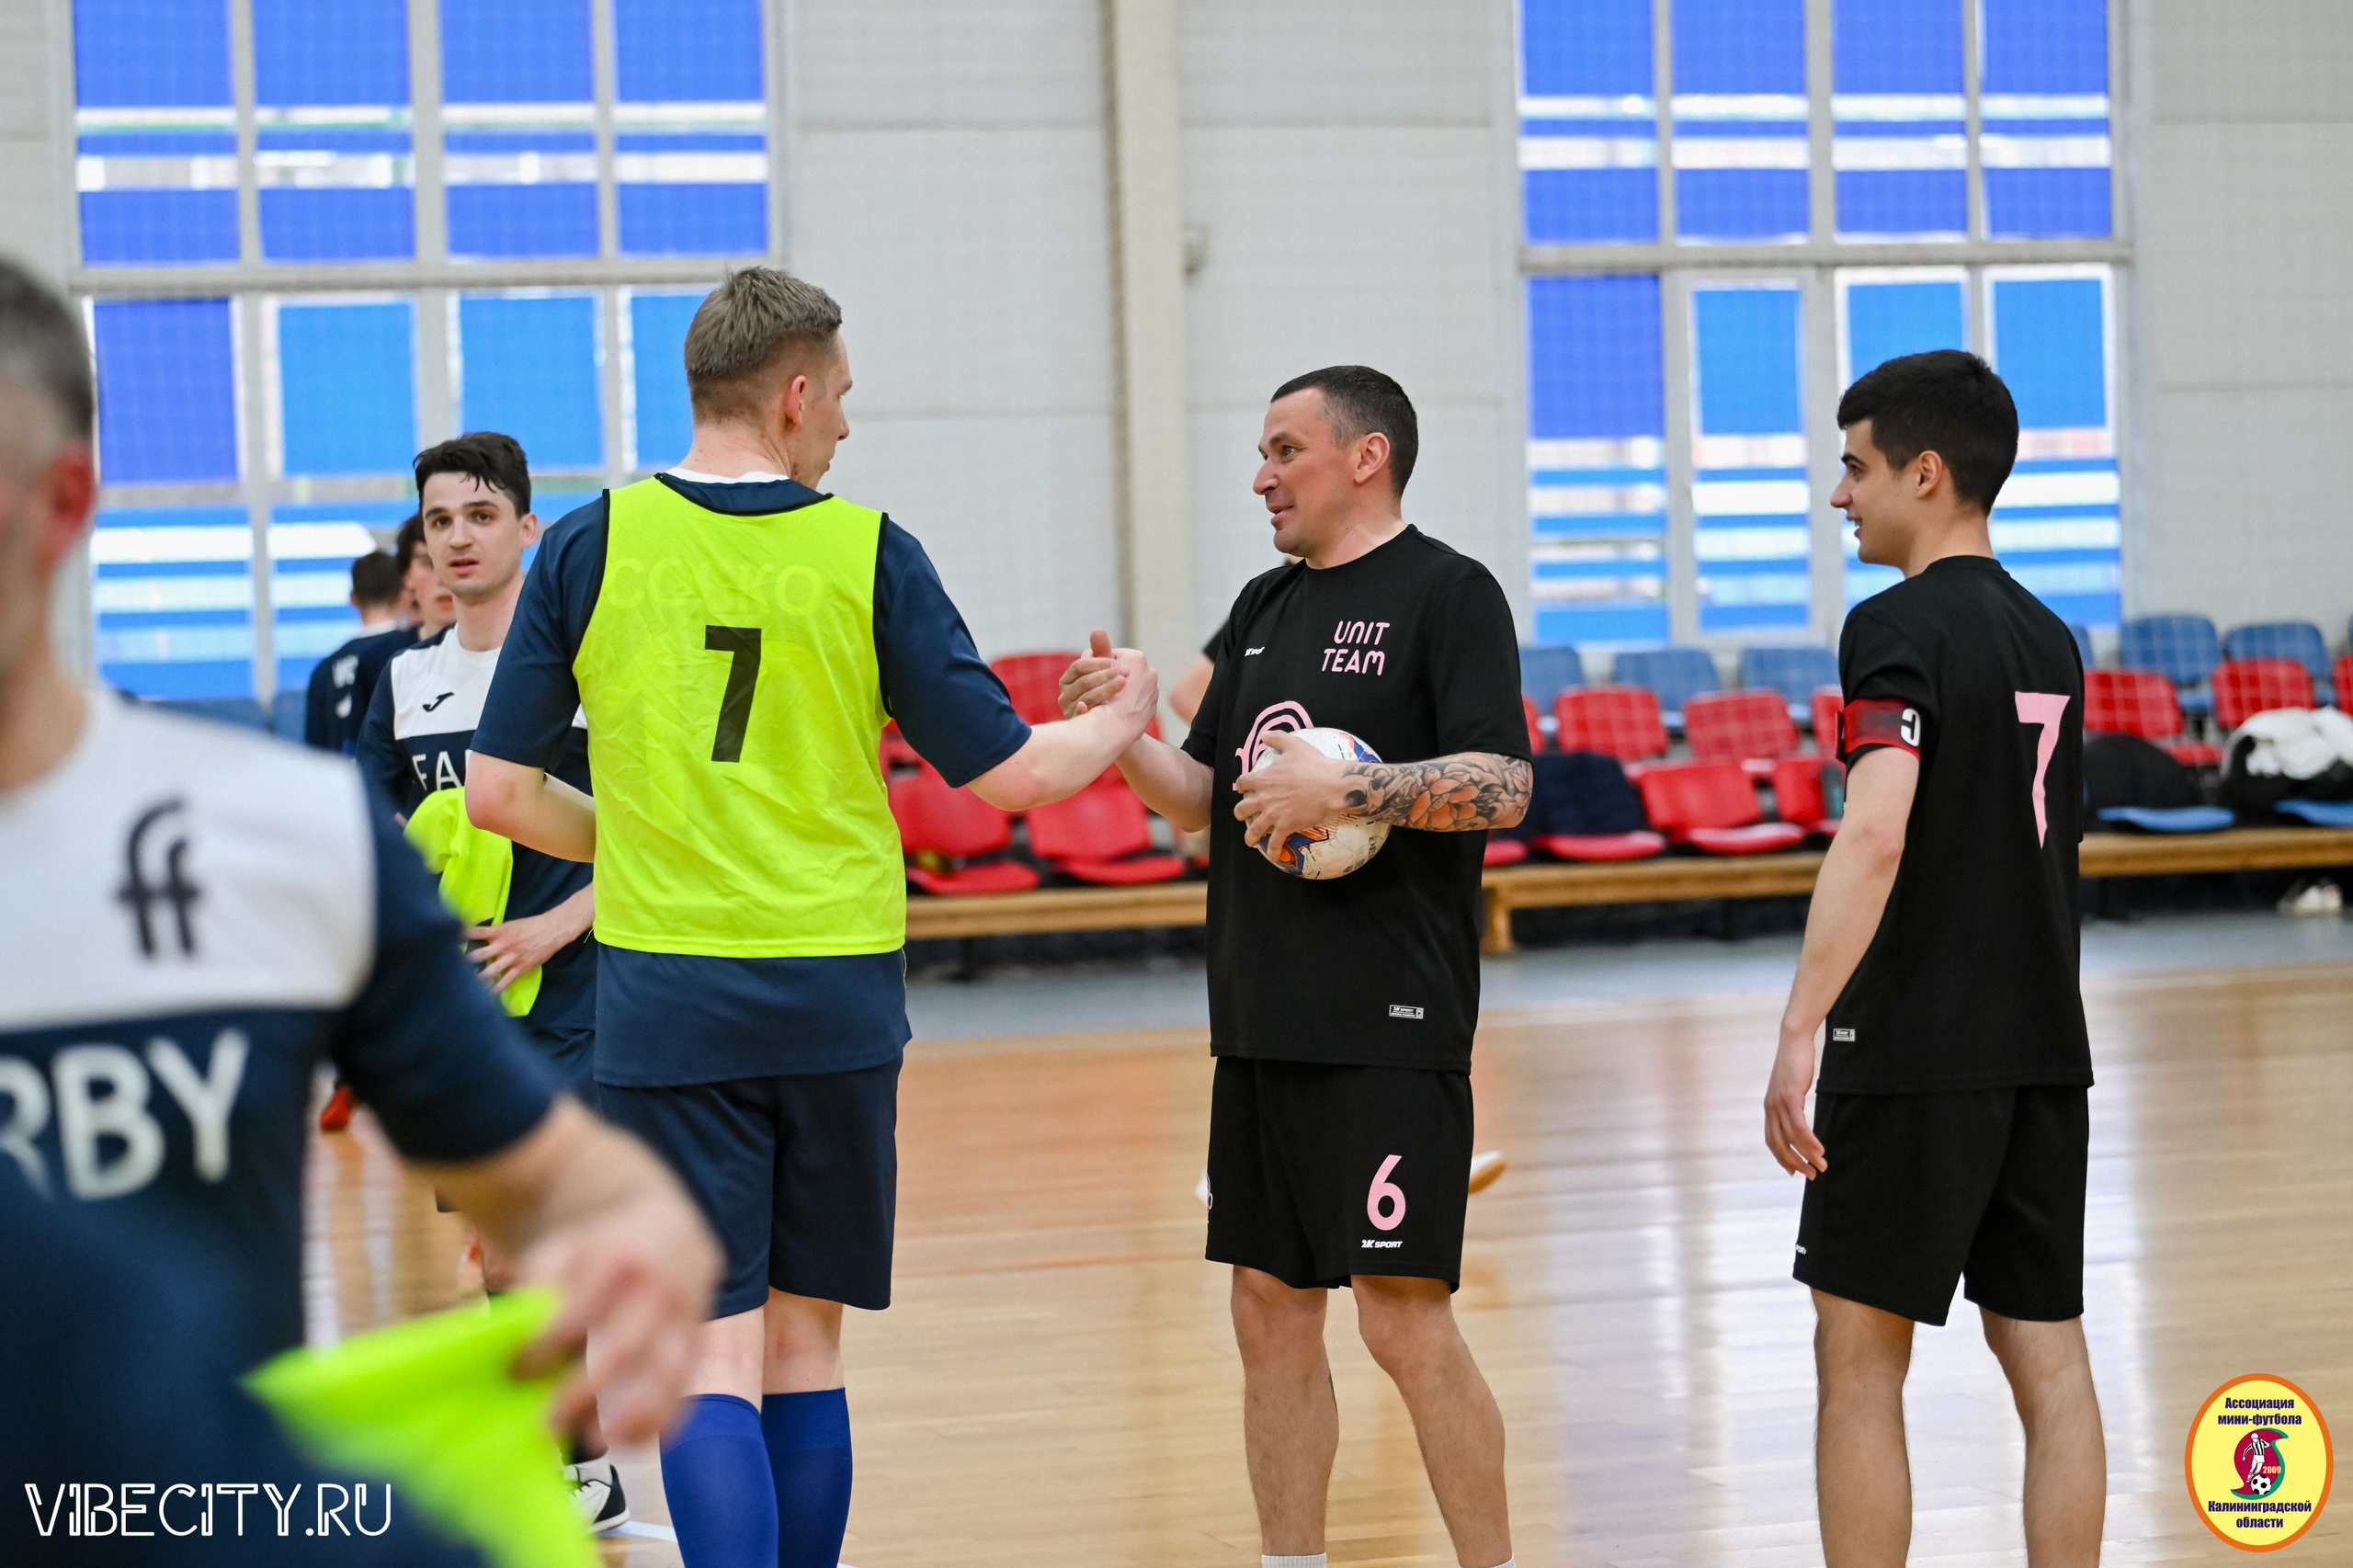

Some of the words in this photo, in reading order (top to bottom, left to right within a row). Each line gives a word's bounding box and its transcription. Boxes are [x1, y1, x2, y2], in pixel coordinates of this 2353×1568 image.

[1334, 620, 1391, 646] UNIT
[1321, 648, 1385, 676] TEAM
[704, 624, 762, 763] 7
[2014, 690, 2071, 849] 7
[1367, 1153, 1406, 1231] 6
[1361, 1239, 1376, 1248] 2K
